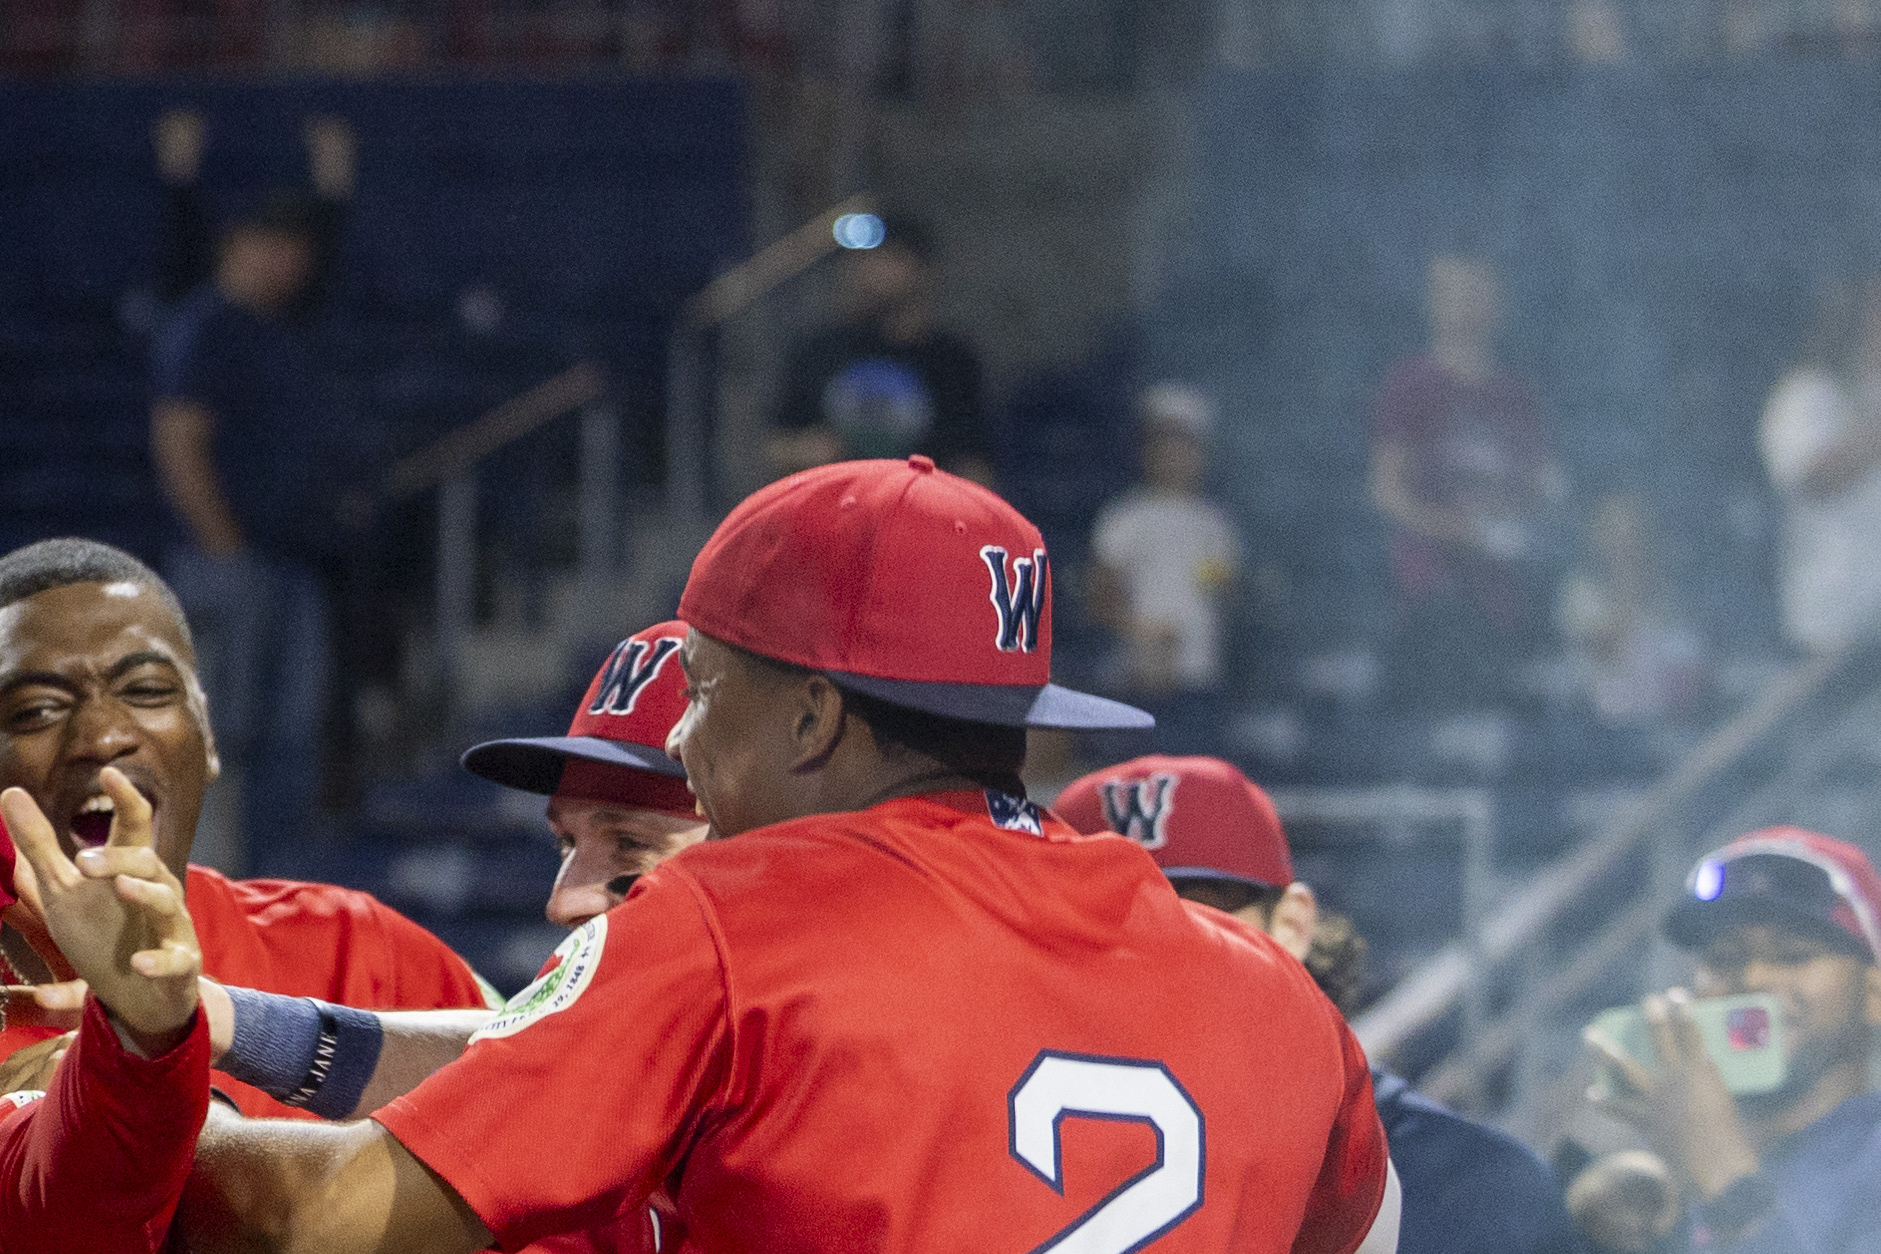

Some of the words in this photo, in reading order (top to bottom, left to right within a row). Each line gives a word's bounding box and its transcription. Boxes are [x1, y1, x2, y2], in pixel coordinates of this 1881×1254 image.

[979, 545, 1047, 653] W
[588, 637, 682, 716] W
[1097, 772, 1179, 849] W
